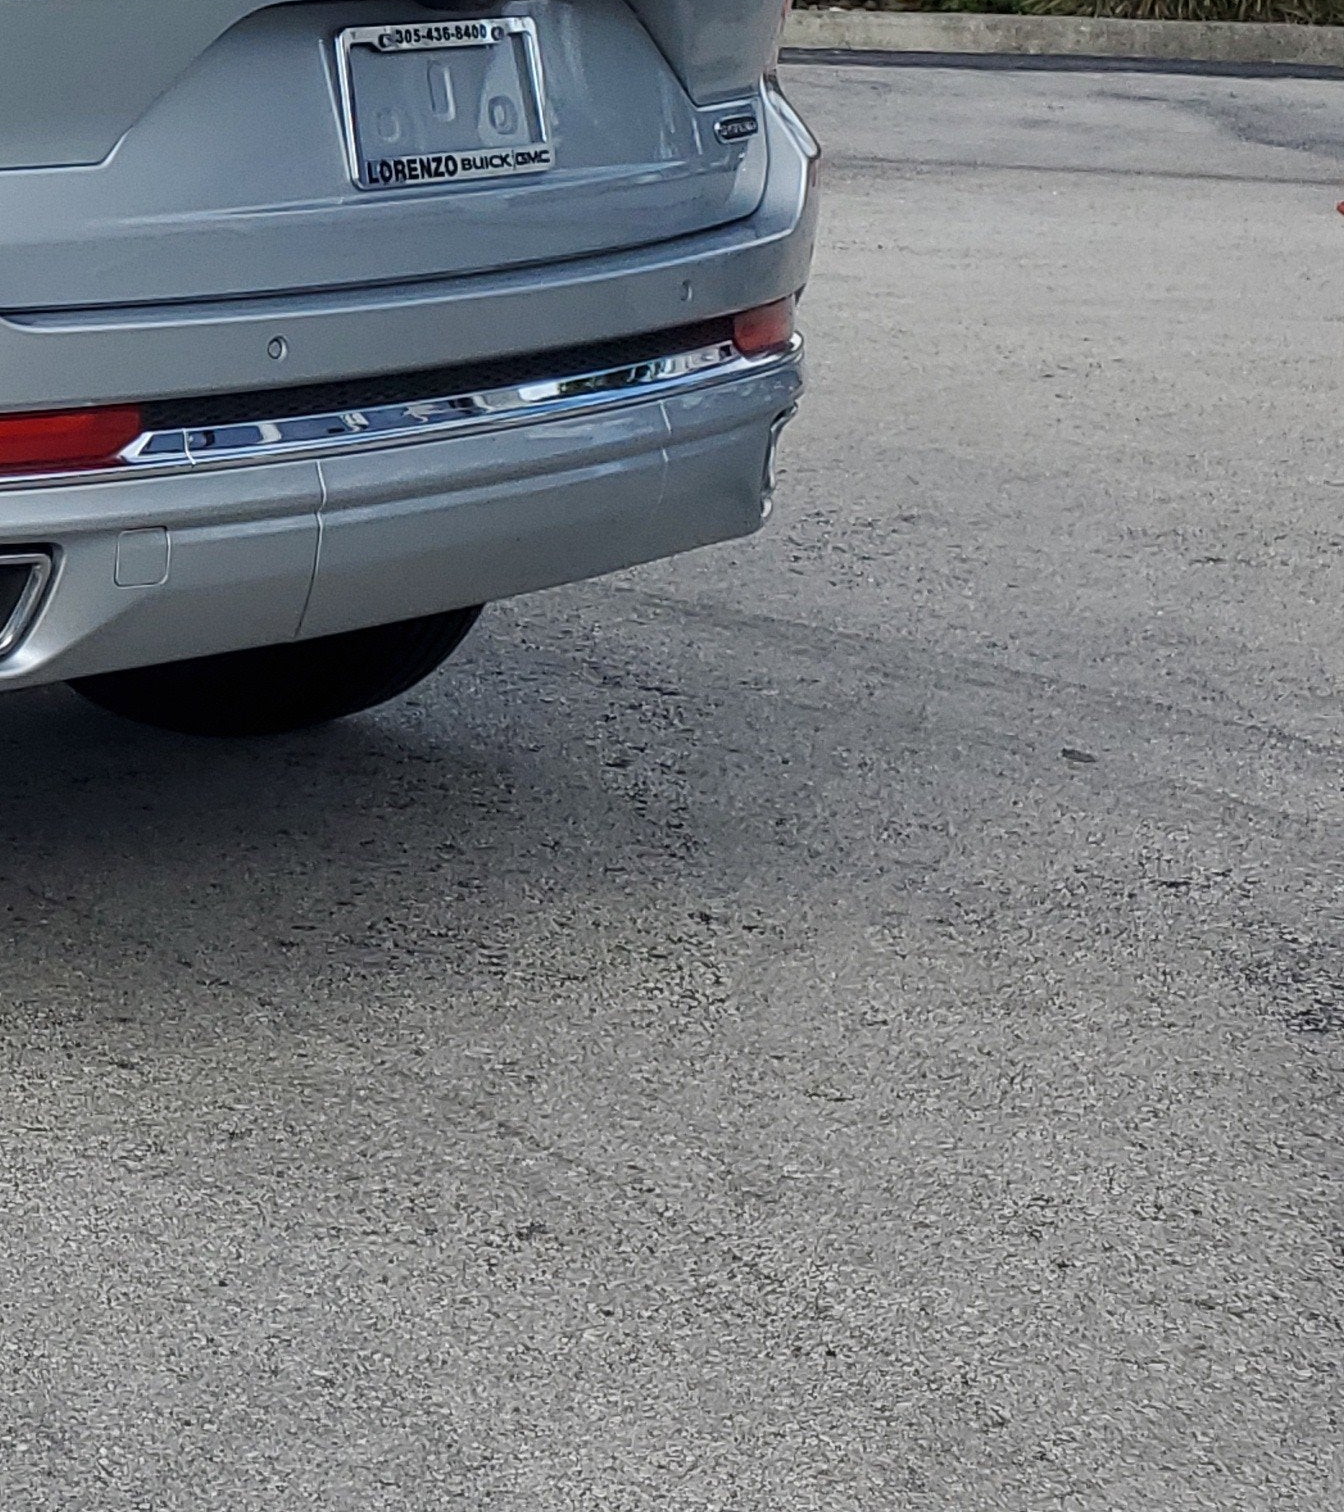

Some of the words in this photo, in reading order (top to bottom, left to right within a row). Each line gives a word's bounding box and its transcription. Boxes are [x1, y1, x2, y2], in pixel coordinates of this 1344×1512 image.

[395, 24, 487, 44] 305-436-8400
[367, 155, 458, 185] LORENZO
[461, 154, 512, 172] BUICK
[514, 149, 551, 167] GMC
